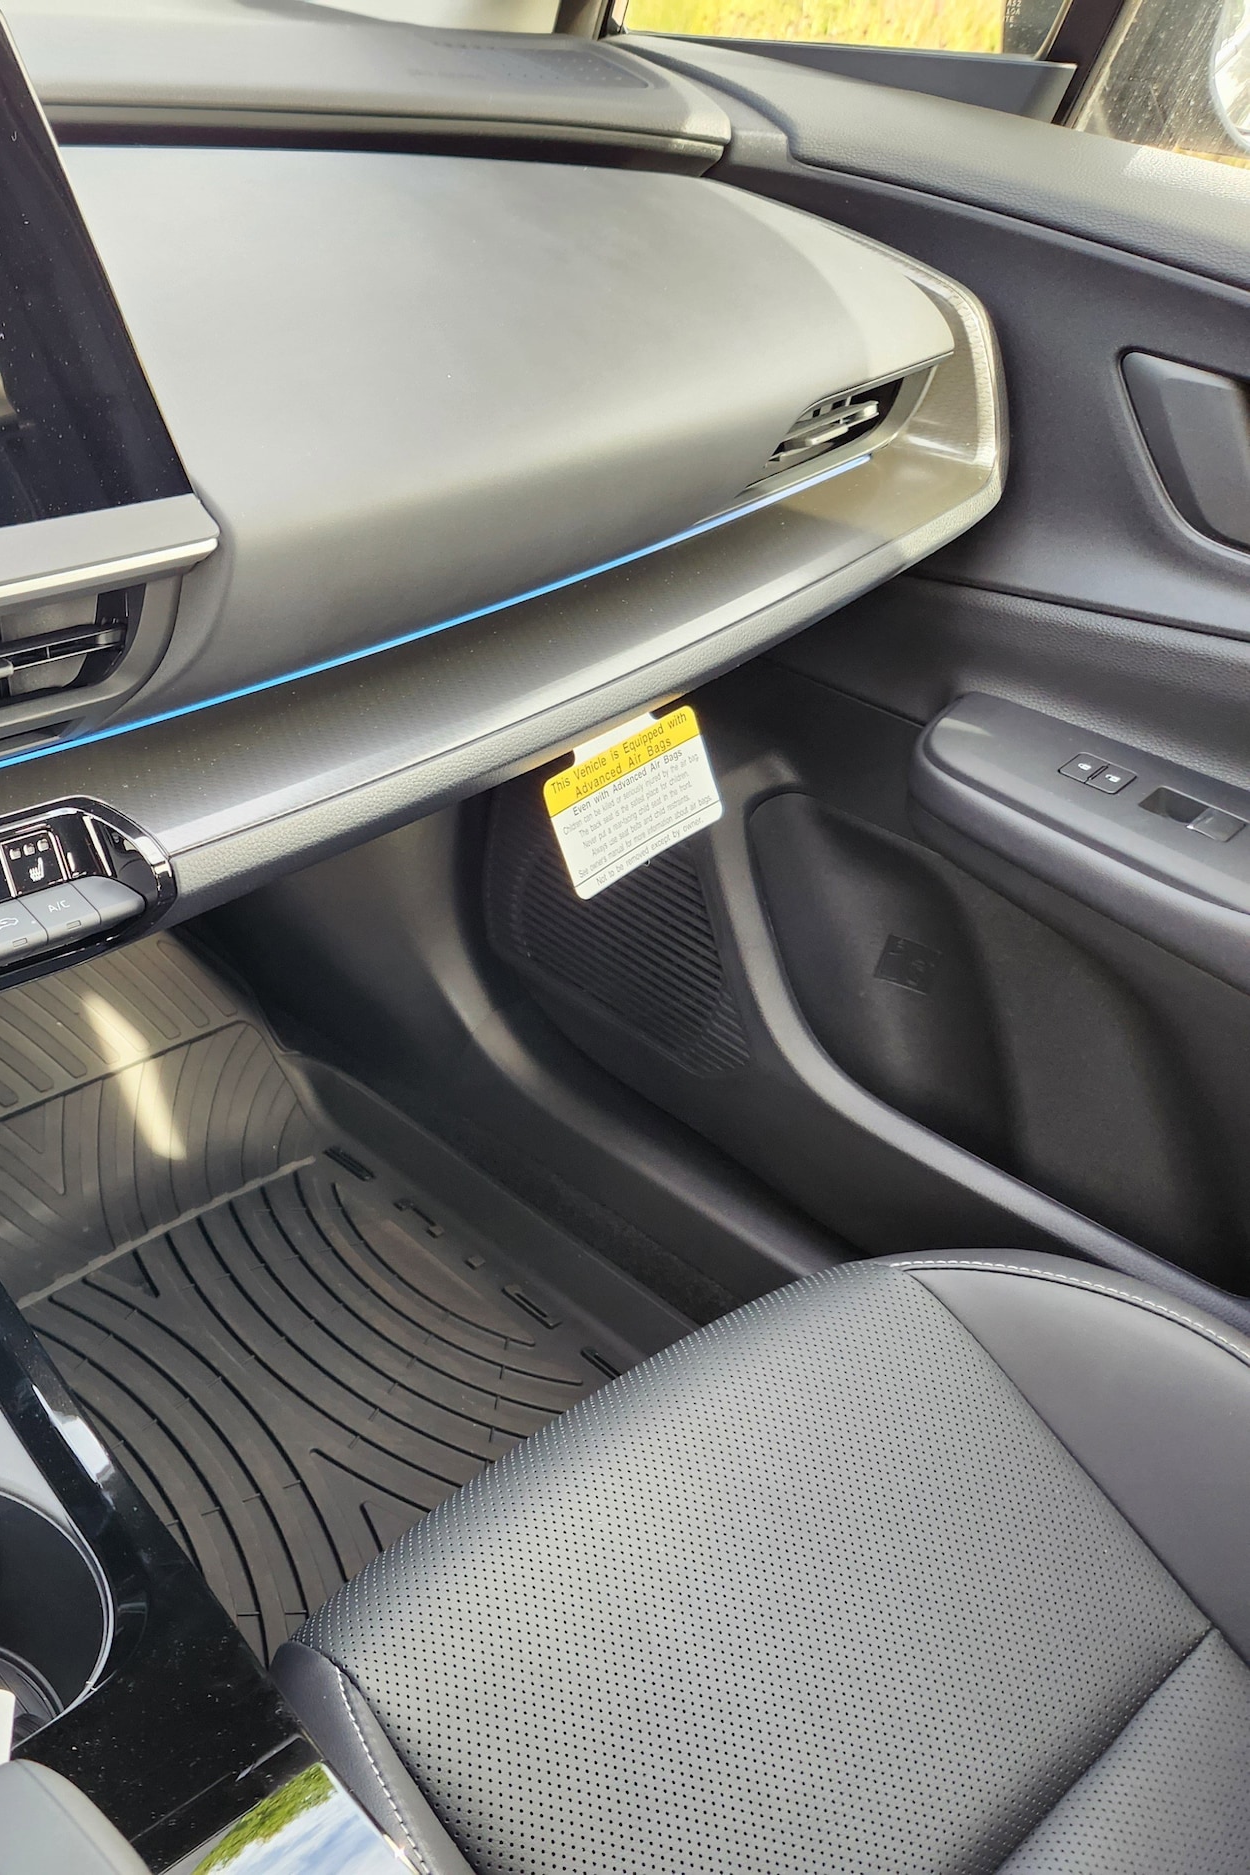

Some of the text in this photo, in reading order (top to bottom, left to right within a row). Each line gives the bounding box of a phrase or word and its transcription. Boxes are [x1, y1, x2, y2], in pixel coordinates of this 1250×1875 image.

[550, 712, 687, 794] This Vehicle is Equipped with
[572, 749, 683, 816] Even with Advanced Air Bags
[575, 738, 672, 797] Advanced Air Bags
[595, 873, 608, 886] Not
[607, 869, 615, 878] to
[615, 863, 624, 873] be
[625, 845, 650, 867] removed
[650, 833, 671, 851] except
[671, 829, 680, 838] by
[47, 899, 71, 913] A/C
